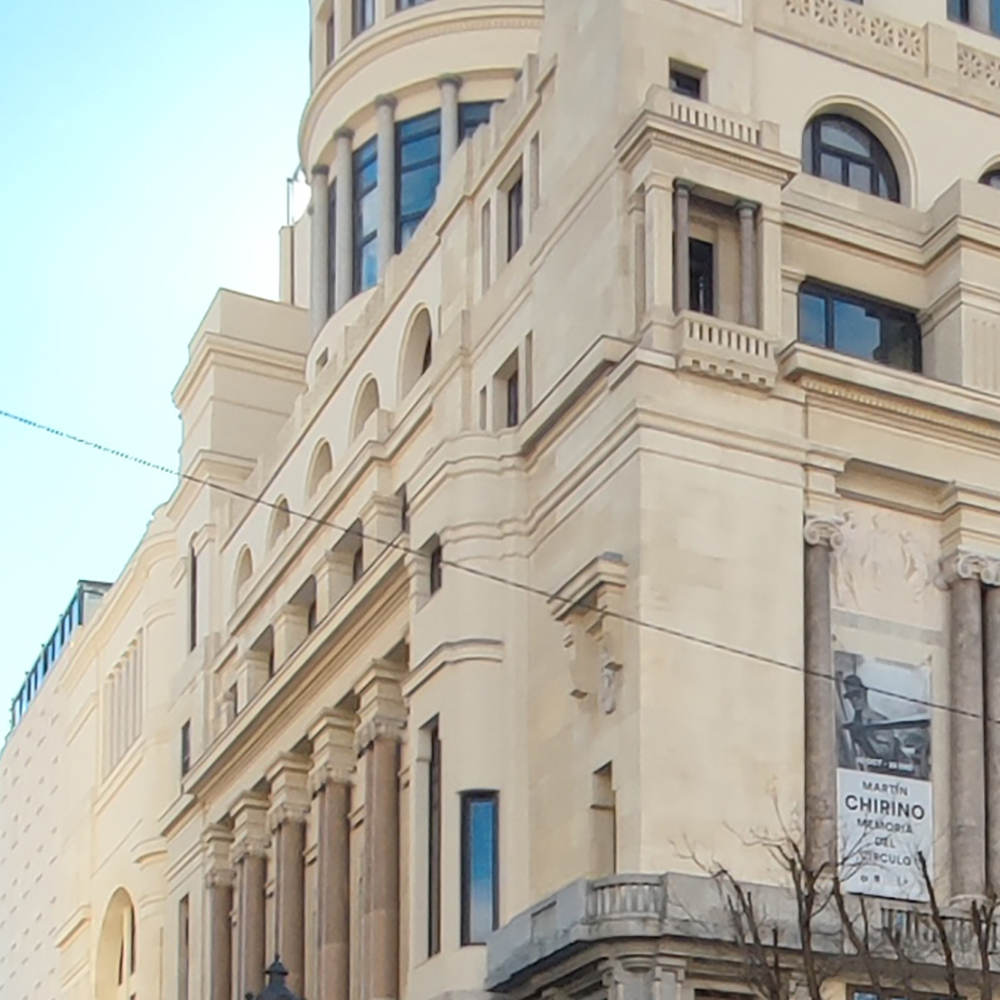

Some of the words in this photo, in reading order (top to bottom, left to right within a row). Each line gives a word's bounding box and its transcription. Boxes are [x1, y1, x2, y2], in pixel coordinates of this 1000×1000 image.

[862, 781, 908, 796] MARTÍN
[845, 794, 925, 820] CHIRINO
[874, 836, 896, 848] DEL
